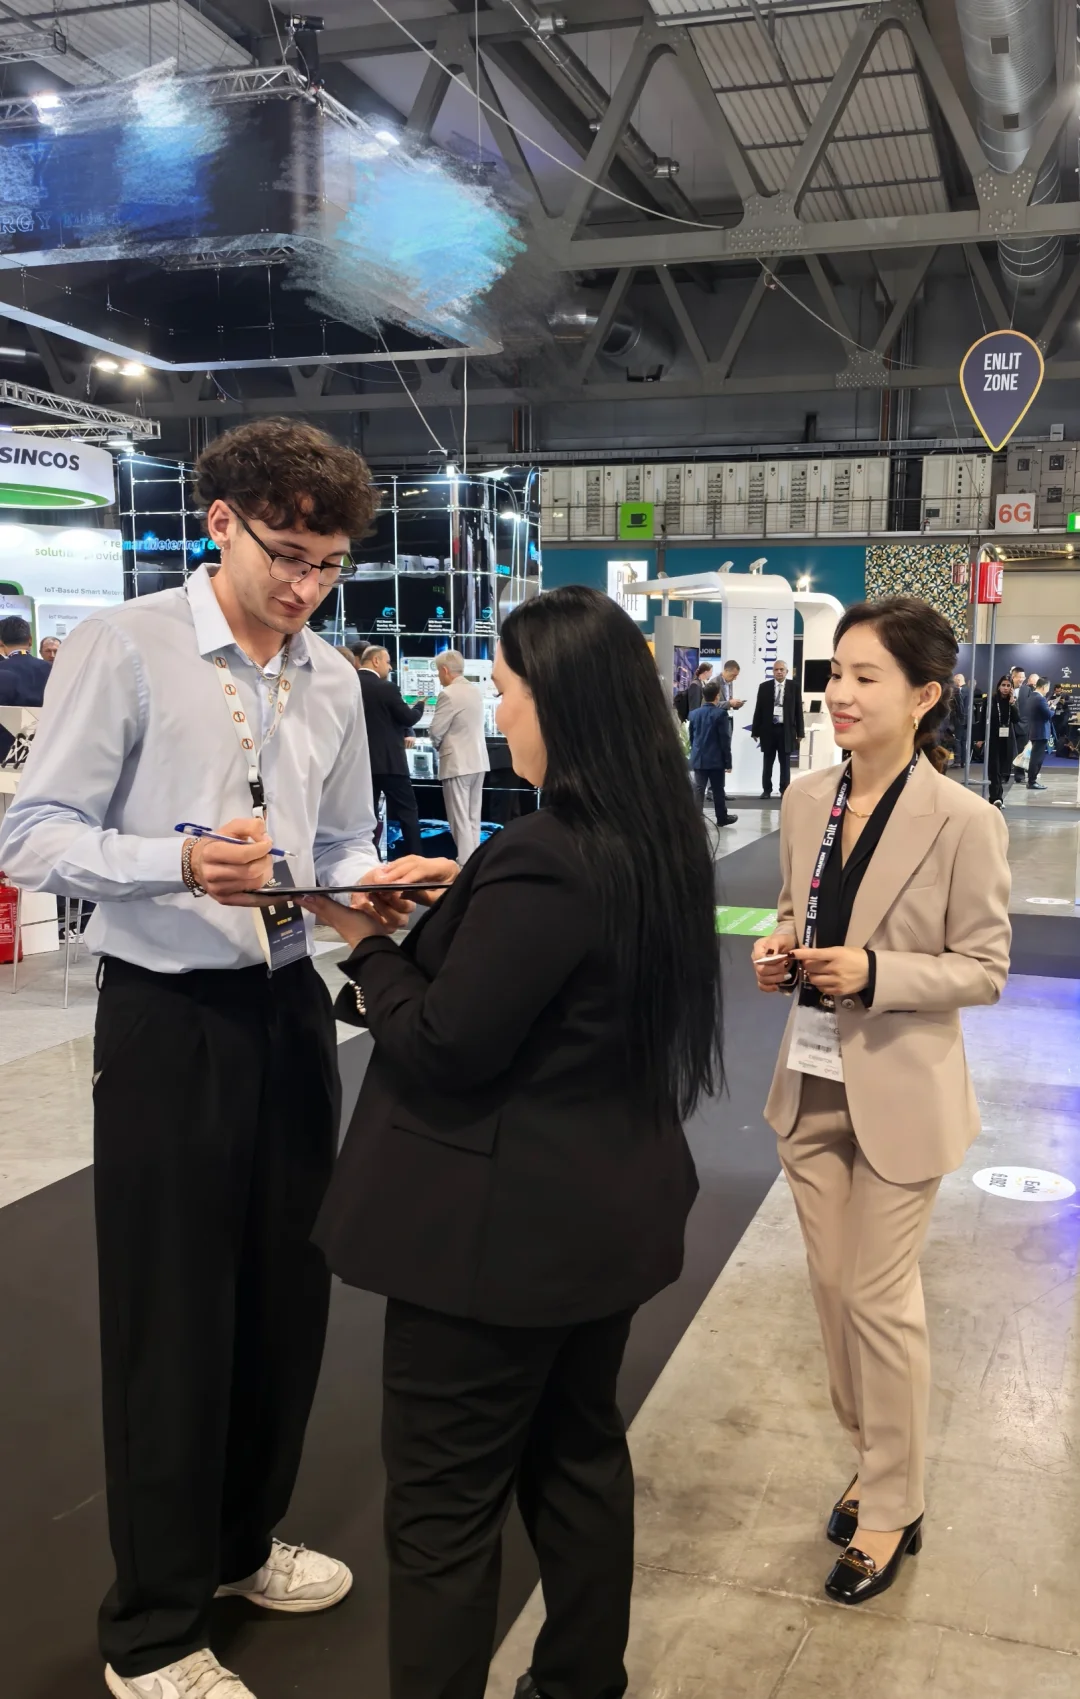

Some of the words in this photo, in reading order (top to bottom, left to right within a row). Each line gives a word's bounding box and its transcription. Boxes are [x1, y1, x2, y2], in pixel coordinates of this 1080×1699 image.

[984, 352, 1022, 371] ENLIT
[983, 373, 1019, 391] ZONE
[0, 447, 80, 471] SINCOS
[998, 502, 1032, 523] 6G
[44, 586, 79, 594] IoT-Based
[836, 782, 848, 806] KRAKEN
[822, 823, 838, 847] Enlit
[814, 851, 827, 877] KRAKEN
[806, 895, 819, 920] Enlit
